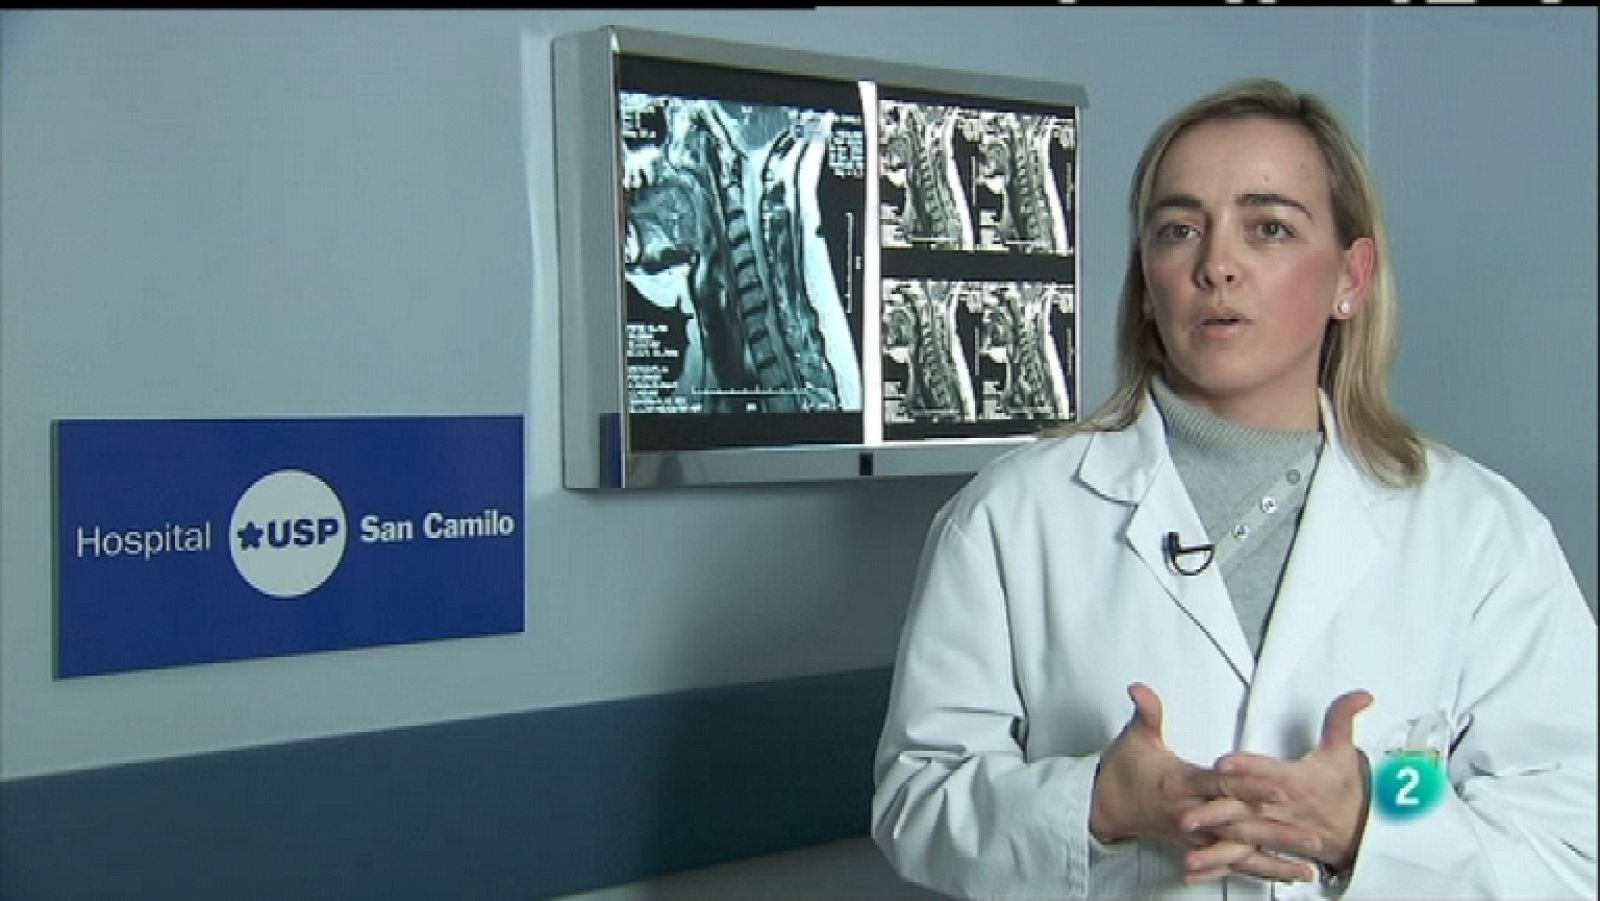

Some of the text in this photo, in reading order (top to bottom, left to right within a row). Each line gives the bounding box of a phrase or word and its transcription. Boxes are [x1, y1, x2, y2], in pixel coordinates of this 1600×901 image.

[76, 508, 515, 560] Hospital USP San Camilo
